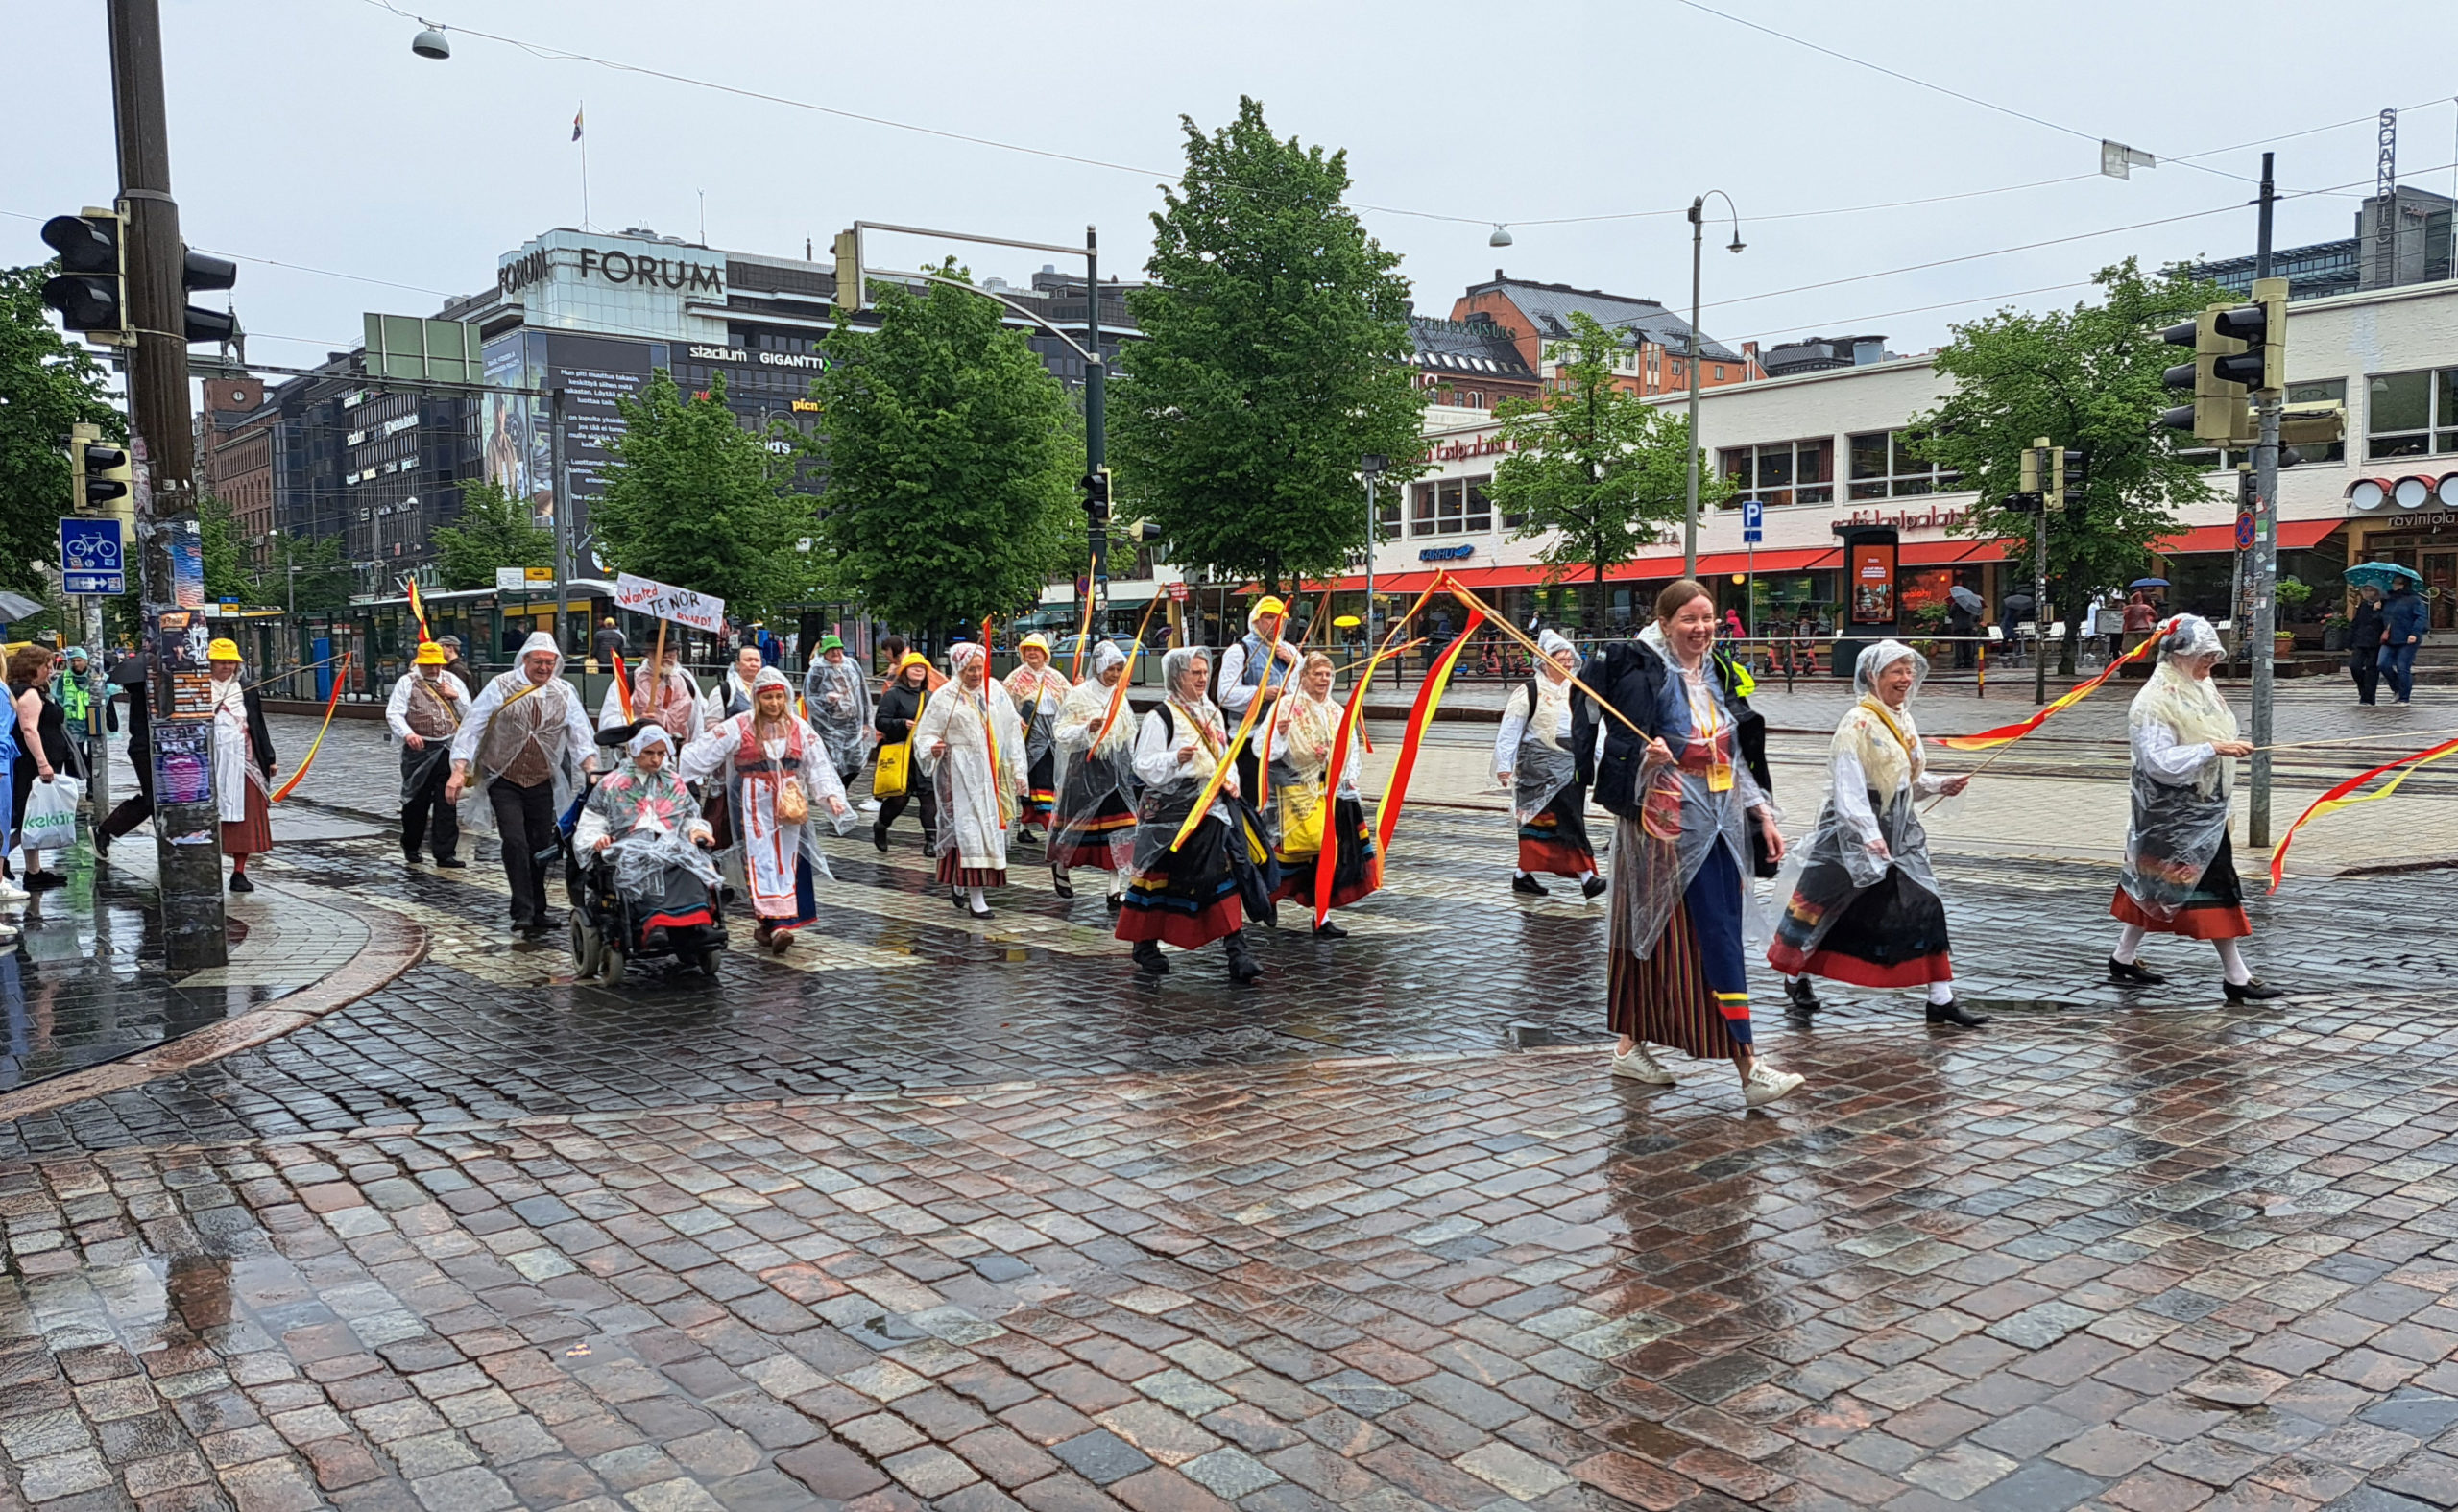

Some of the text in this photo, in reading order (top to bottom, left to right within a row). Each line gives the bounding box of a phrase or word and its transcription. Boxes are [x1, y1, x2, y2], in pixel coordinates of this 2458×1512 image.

[2376, 108, 2395, 243] SCANDIC
[498, 247, 547, 297] FORUM
[581, 248, 722, 294] FORUM
[689, 345, 747, 362] stadium
[759, 352, 823, 370] GIGANTTI
[1747, 504, 1759, 526] P
[2389, 509, 2455, 527] ravintola
[1421, 548, 1454, 560] KARHU
[619, 584, 658, 605] Wanted
